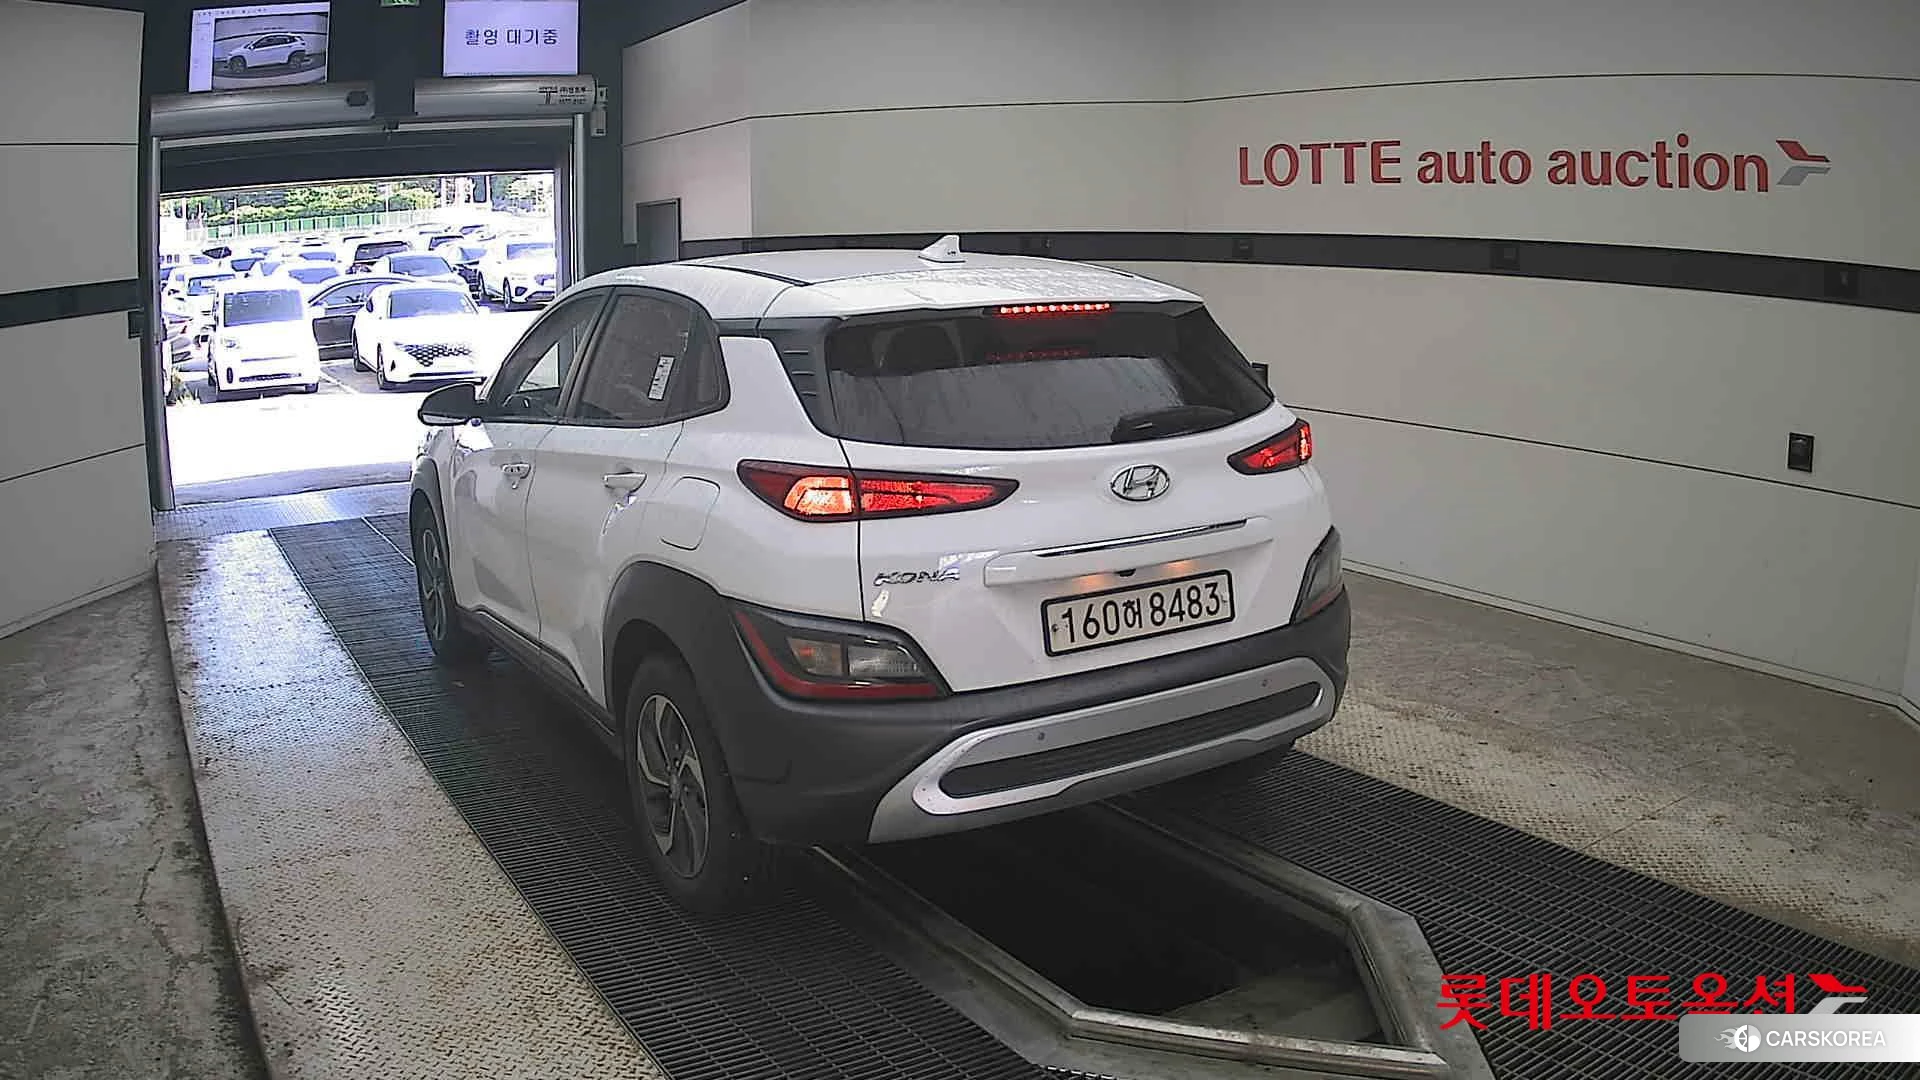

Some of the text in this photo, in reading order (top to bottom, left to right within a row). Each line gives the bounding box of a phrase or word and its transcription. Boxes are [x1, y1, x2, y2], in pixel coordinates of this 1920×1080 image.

[465, 29, 558, 46] 촬영 대기중
[1239, 133, 1769, 193] LOTTE auto auction
[873, 569, 960, 587] KONA
